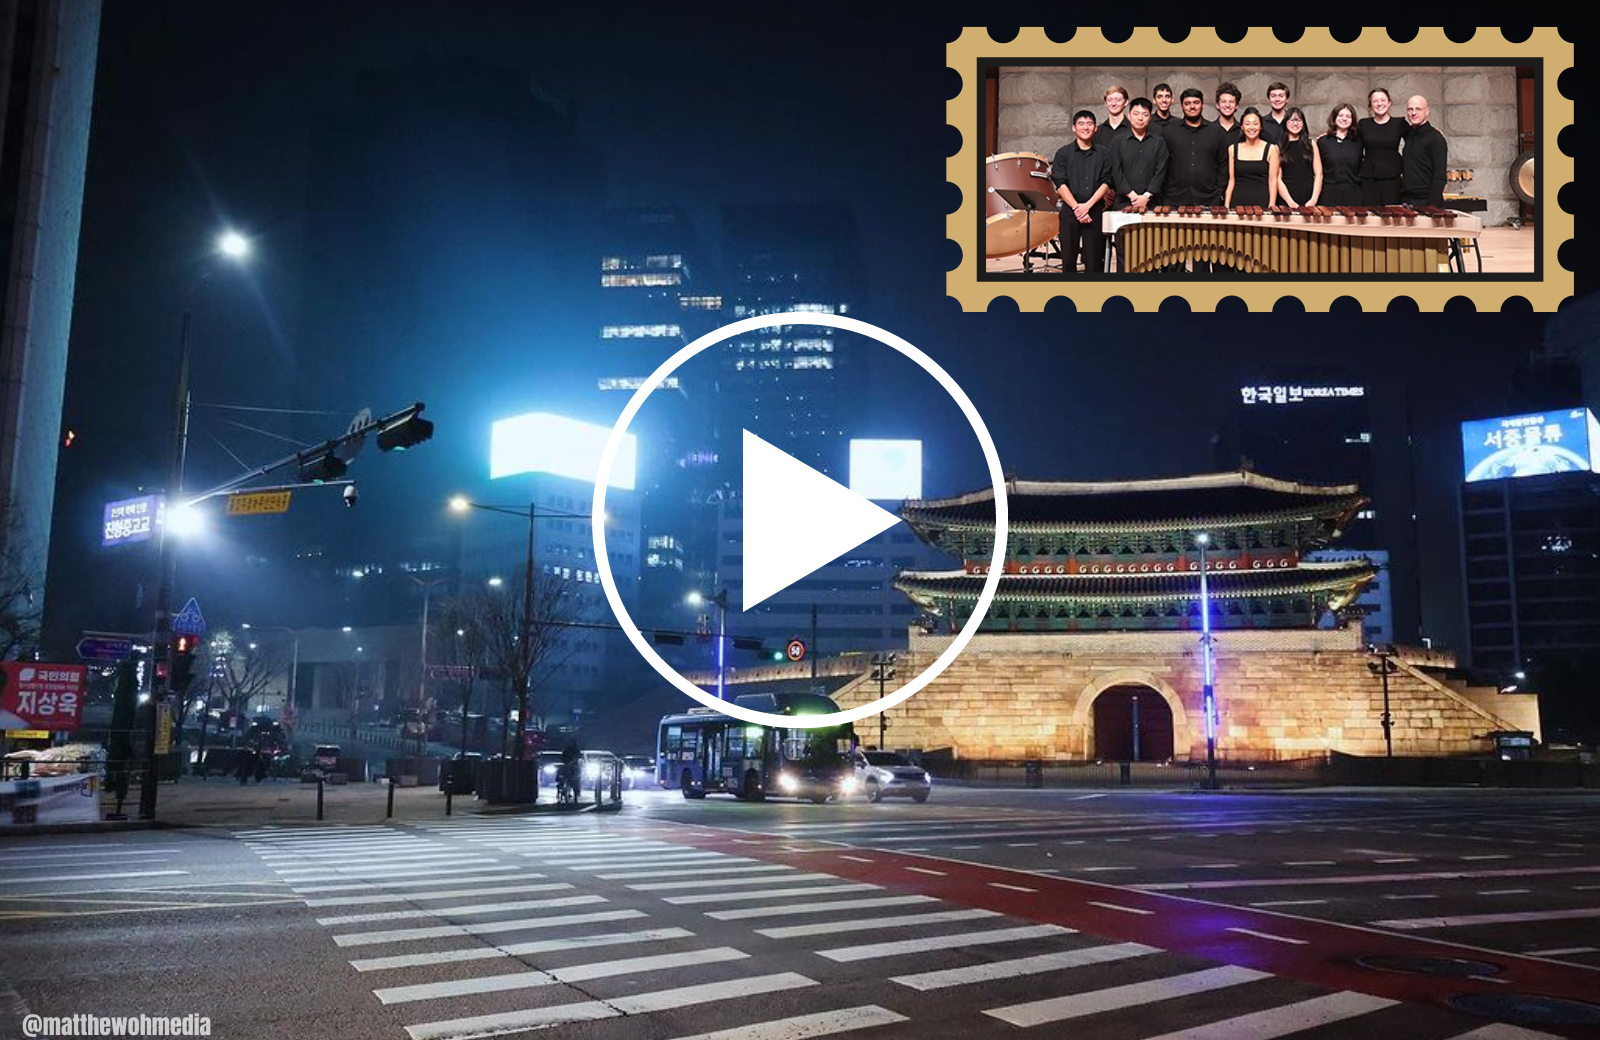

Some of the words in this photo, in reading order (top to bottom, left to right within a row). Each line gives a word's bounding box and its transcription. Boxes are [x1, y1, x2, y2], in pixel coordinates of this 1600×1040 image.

[1240, 386, 1303, 403] 한국일보
[37, 671, 80, 682] 국민의힘
[16, 691, 77, 717] 지상욱
